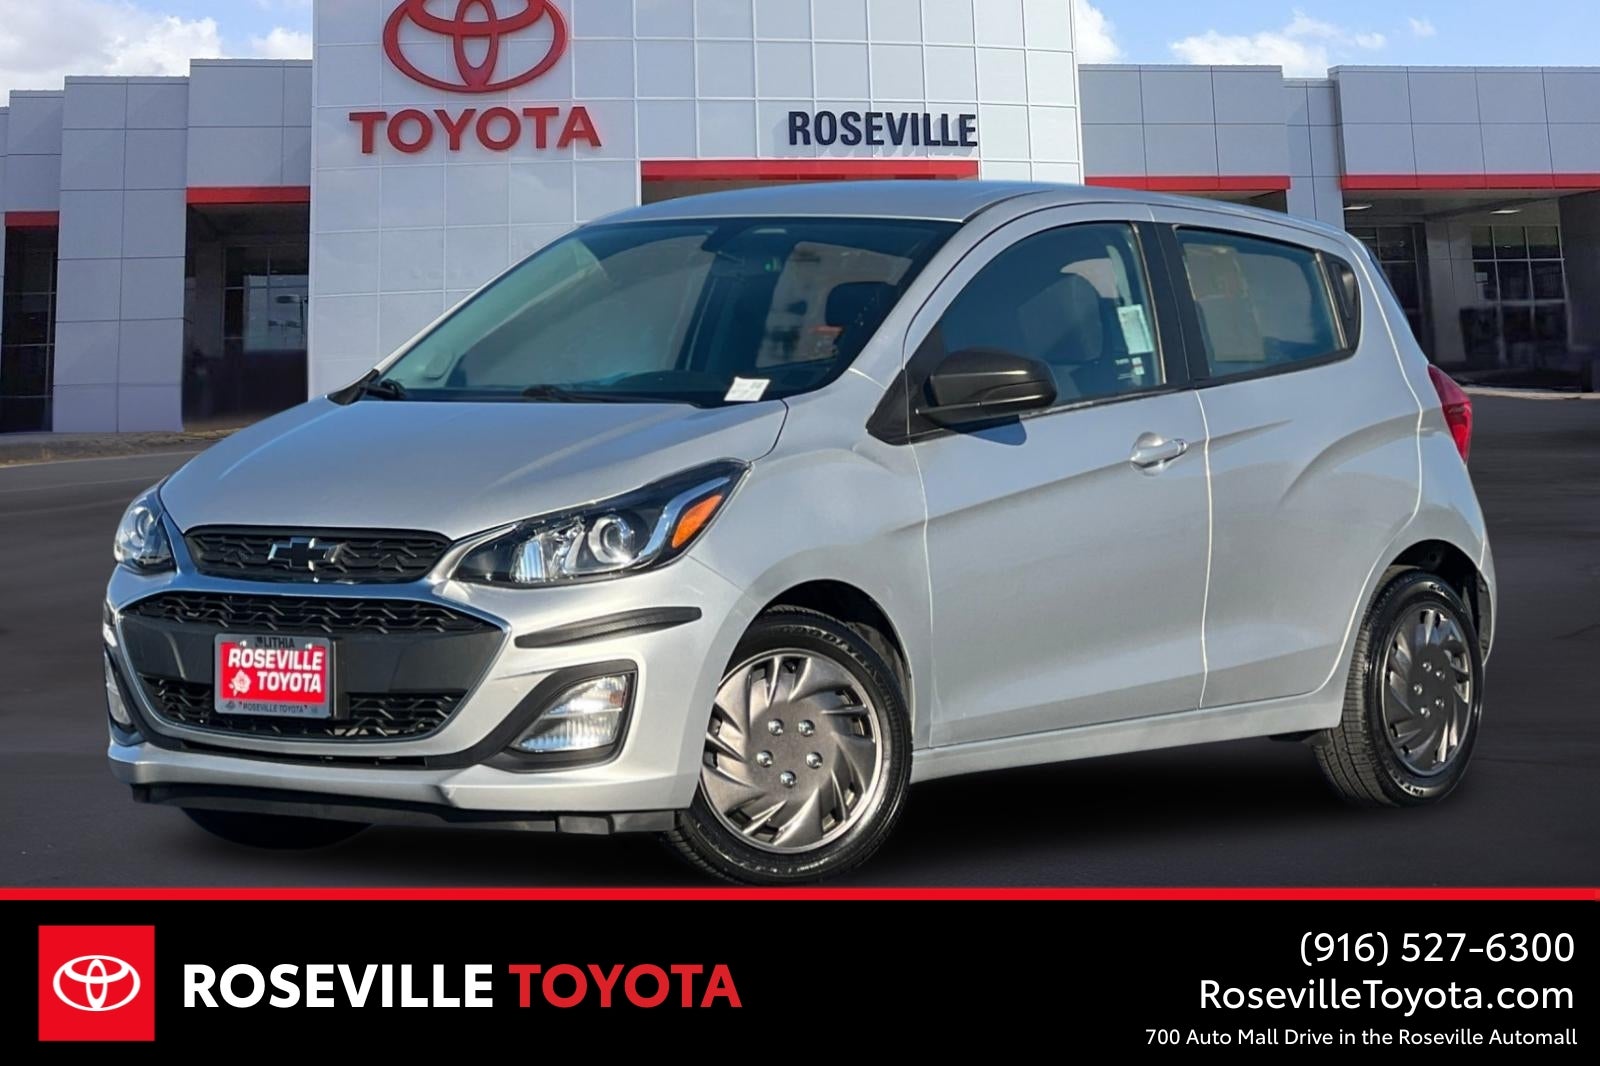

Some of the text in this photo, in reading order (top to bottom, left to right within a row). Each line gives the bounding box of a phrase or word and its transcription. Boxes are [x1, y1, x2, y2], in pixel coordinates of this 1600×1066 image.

[349, 105, 601, 154] TOYOTA
[789, 111, 978, 148] ROSEVILLE
[264, 637, 295, 649] LITHIA
[228, 648, 324, 671] ROSEVILLE
[257, 671, 322, 693] TOYOTA
